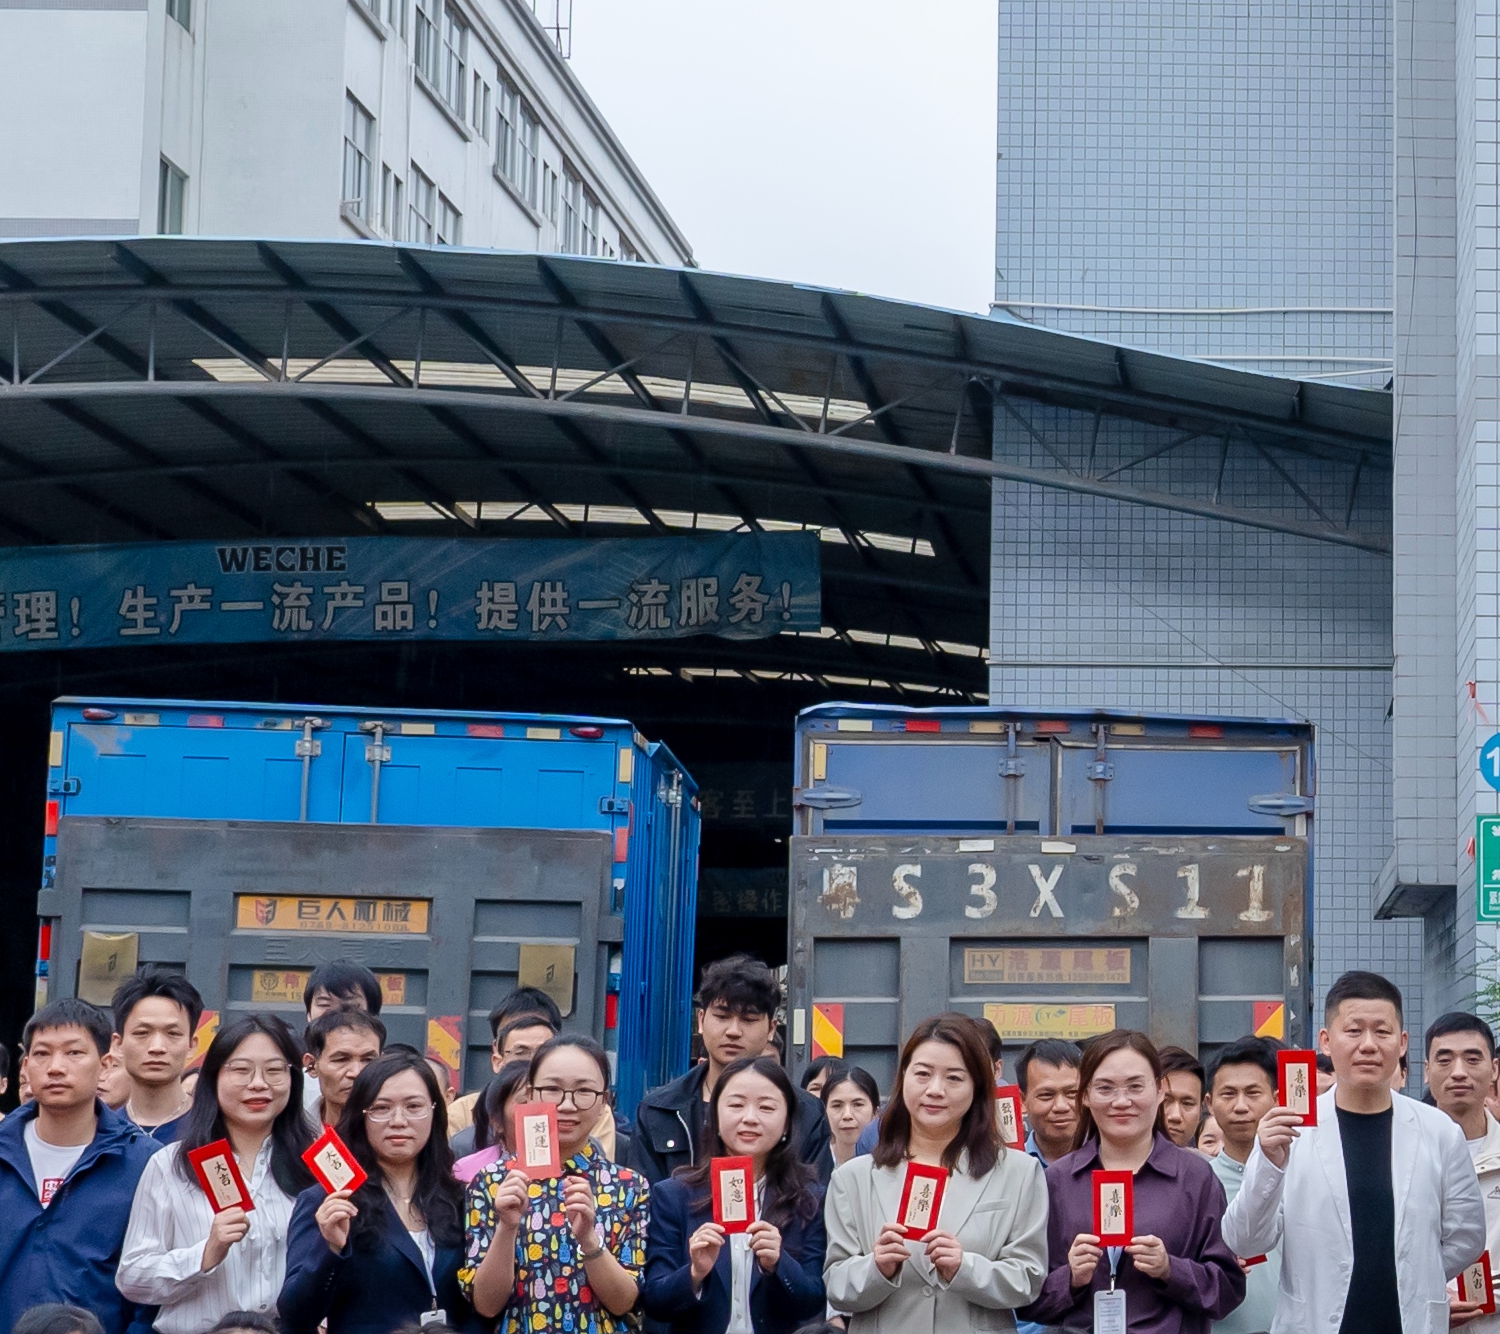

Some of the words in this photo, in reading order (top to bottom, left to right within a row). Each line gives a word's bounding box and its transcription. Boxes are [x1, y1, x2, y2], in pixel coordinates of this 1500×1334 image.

[216, 545, 349, 574] WECHE
[297, 900, 411, 923] 巨人机械
[971, 953, 1000, 967] HY
[1294, 1068, 1307, 1097] 喜樂
[1000, 1098, 1013, 1126] 發財
[532, 1121, 549, 1149] 好運
[214, 1159, 231, 1187] 大吉
[324, 1149, 342, 1171] 大吉
[728, 1176, 744, 1203] 如意
[916, 1183, 933, 1211] 喜樂
[1109, 1189, 1123, 1217] 喜樂
[1471, 1267, 1483, 1290] 大吉
